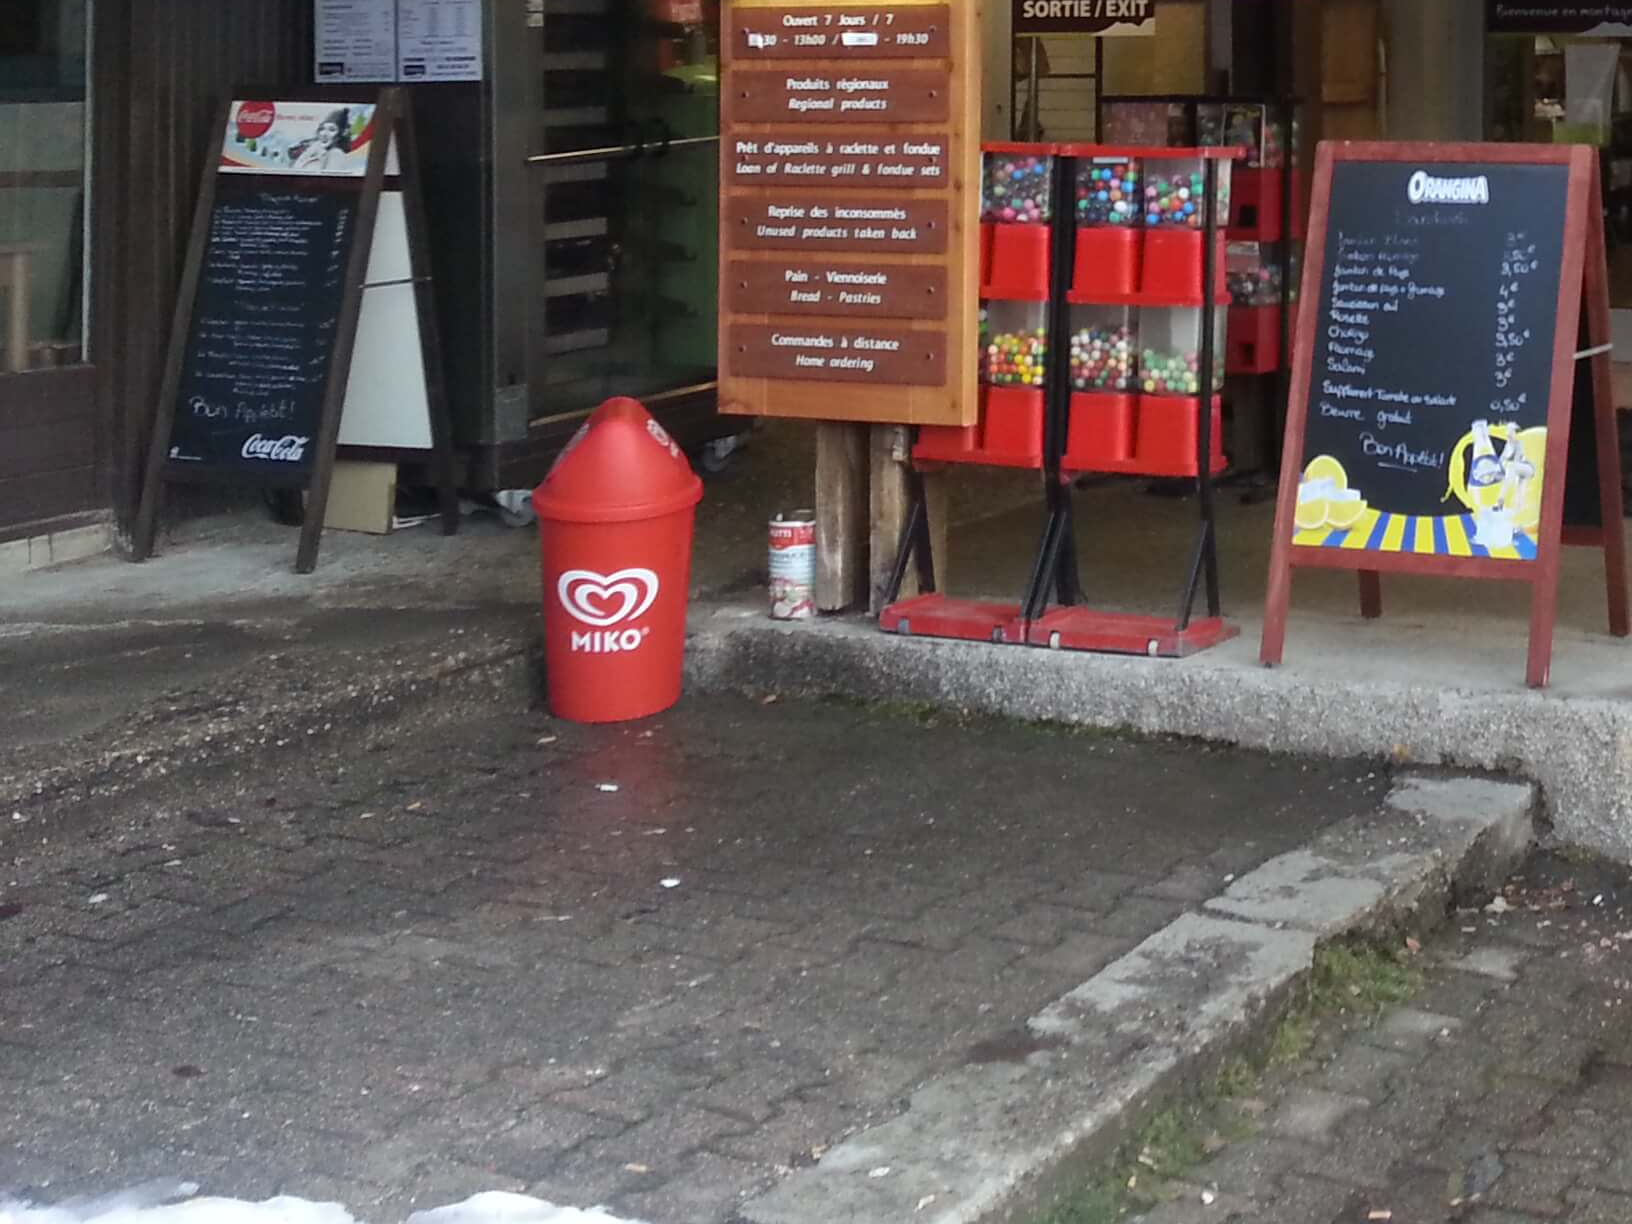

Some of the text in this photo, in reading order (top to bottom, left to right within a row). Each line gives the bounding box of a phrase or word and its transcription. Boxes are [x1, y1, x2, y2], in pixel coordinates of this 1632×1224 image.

[1023, 0, 1092, 18] SORTIE
[1106, 0, 1148, 17] EXIT
[783, 15, 817, 26] Ouvert
[824, 15, 832, 24] 7
[838, 14, 865, 26] Jours
[886, 14, 894, 25] 7
[794, 35, 826, 45] 13h00
[896, 33, 929, 45] 19h30
[786, 78, 830, 90] Produits
[788, 98, 887, 111] Regional products
[840, 143, 879, 155] raclette
[884, 144, 896, 155] et
[904, 143, 941, 155] fondue
[736, 163, 940, 177] Loan of Raclette grill & fondue sets
[1408, 170, 1489, 204] ORANGINA
[768, 205, 805, 219] Reprise
[810, 206, 828, 218] des
[757, 226, 917, 239] Unused products taken back
[785, 270, 808, 282] Pain
[826, 271, 887, 285] Viennoiserie
[790, 290, 820, 302] Bread
[839, 291, 881, 304] Pastries
[771, 333, 834, 347] Commandes
[854, 336, 899, 350] distance
[796, 354, 874, 372] Home ordering
[571, 629, 641, 652] MIKO
